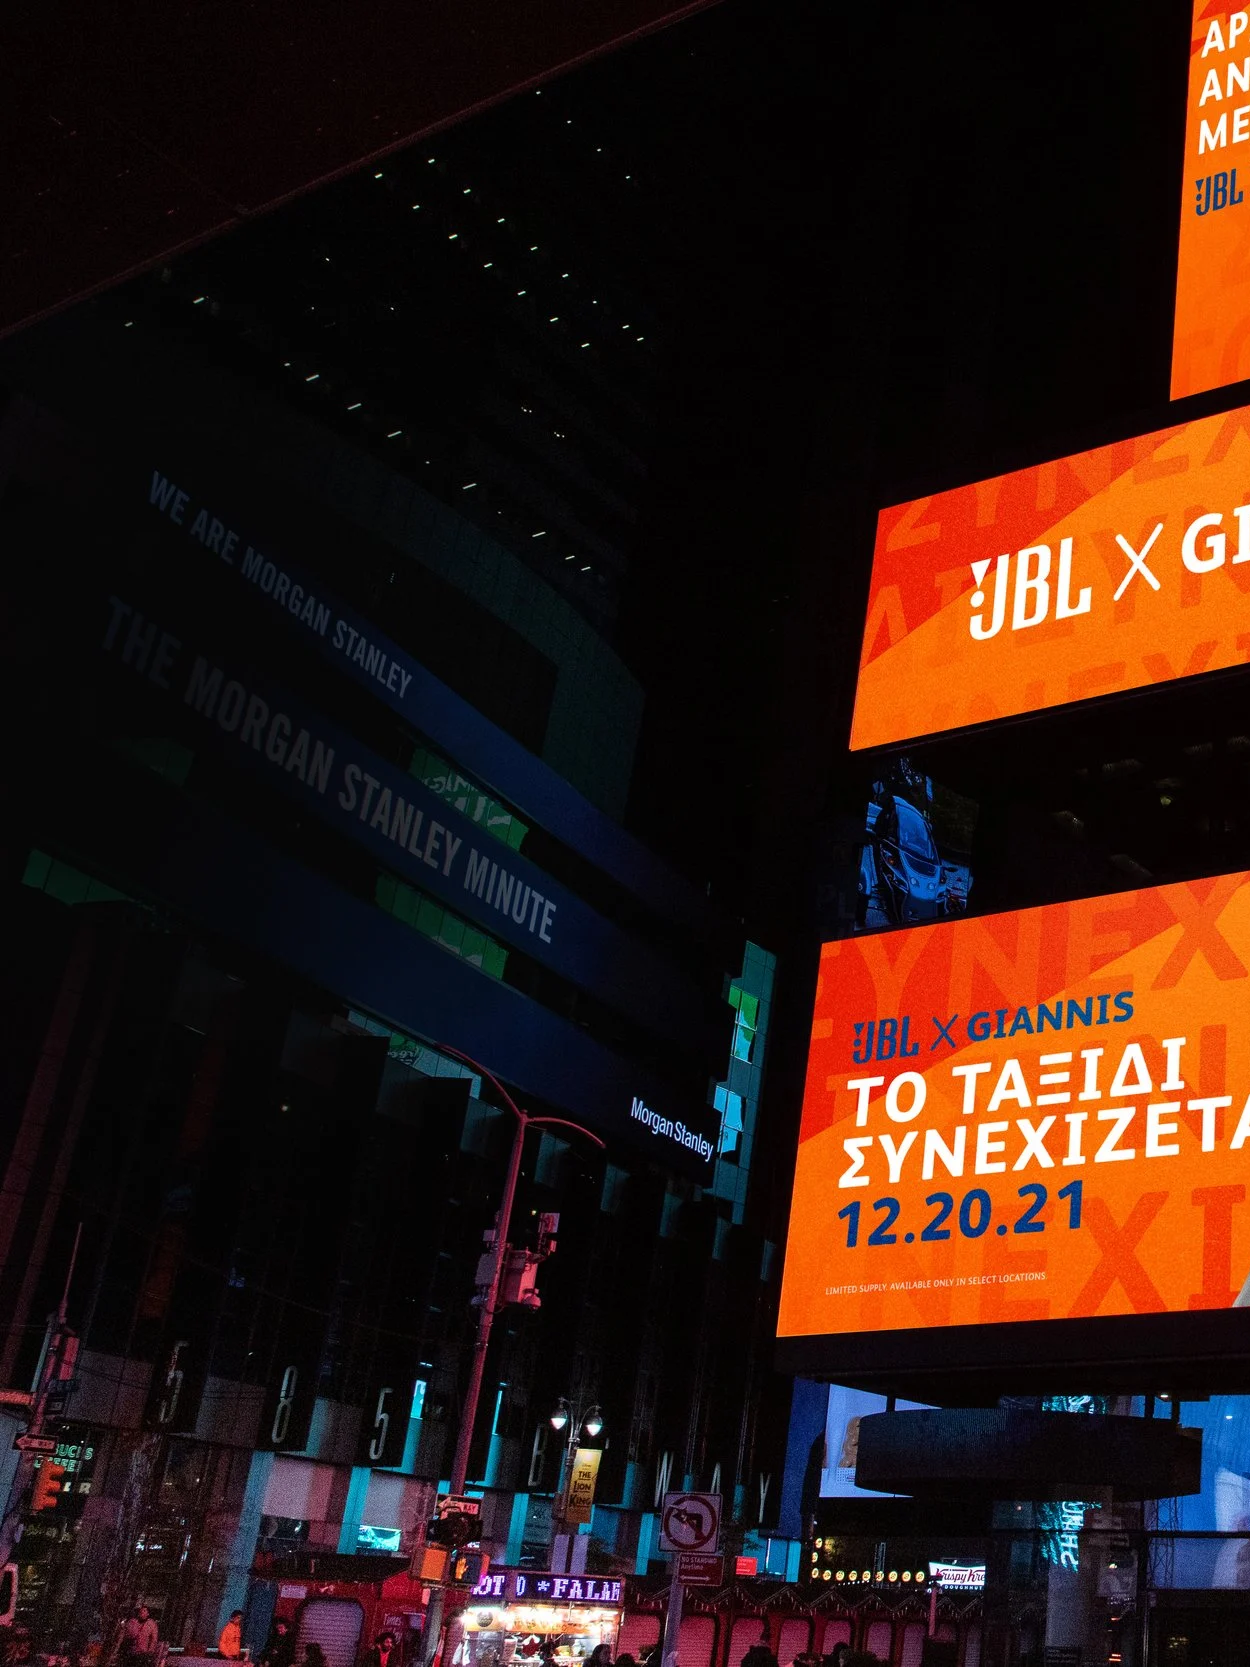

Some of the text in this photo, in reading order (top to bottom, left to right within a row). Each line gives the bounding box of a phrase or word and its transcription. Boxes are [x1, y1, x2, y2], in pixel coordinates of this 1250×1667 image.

[1195, 168, 1244, 216] JBL
[148, 469, 413, 699] WE ARE MORGAN STANLEY
[969, 537, 1092, 641] JBL
[1113, 523, 1164, 601] X
[101, 595, 557, 945] THE MORGAN STANLEY MINUTE
[853, 990, 1134, 1064] JBL X GIANNIS
[846, 1037, 1187, 1128] ΤΟ ΤΑΞΙΔΙ
[836, 1180, 1085, 1249] 12.20.21
[825, 1285, 858, 1296] LIMITED
[890, 1279, 931, 1290] AVAILABLE
[933, 1278, 954, 1288] ONLY
[956, 1277, 967, 1286] IN
[968, 1275, 996, 1285] SELECT
